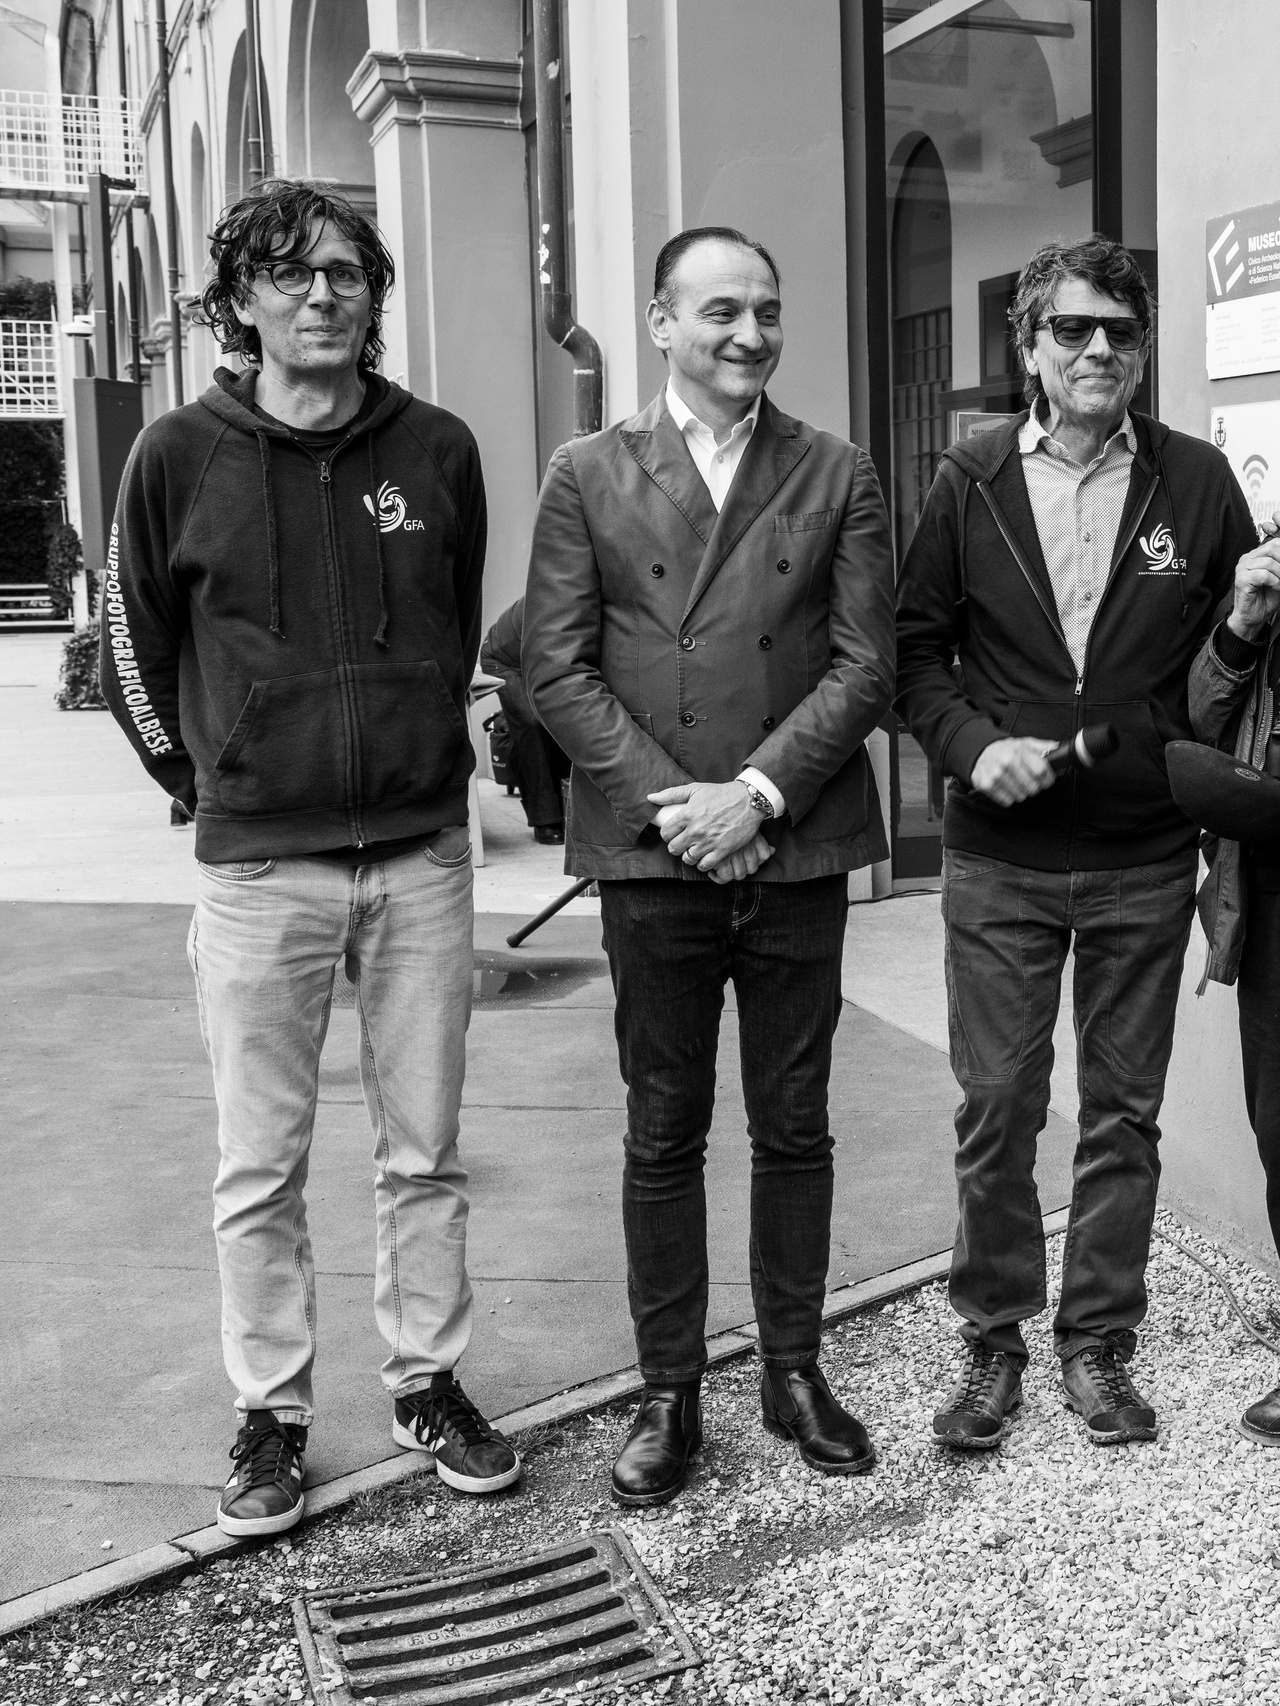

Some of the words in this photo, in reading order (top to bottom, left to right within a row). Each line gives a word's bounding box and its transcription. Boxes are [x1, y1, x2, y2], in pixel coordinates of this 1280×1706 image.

[1248, 257, 1261, 265] Civico
[403, 519, 425, 531] GFA
[106, 522, 173, 756] GRUPPOFOTOGRAFICOALBESE
